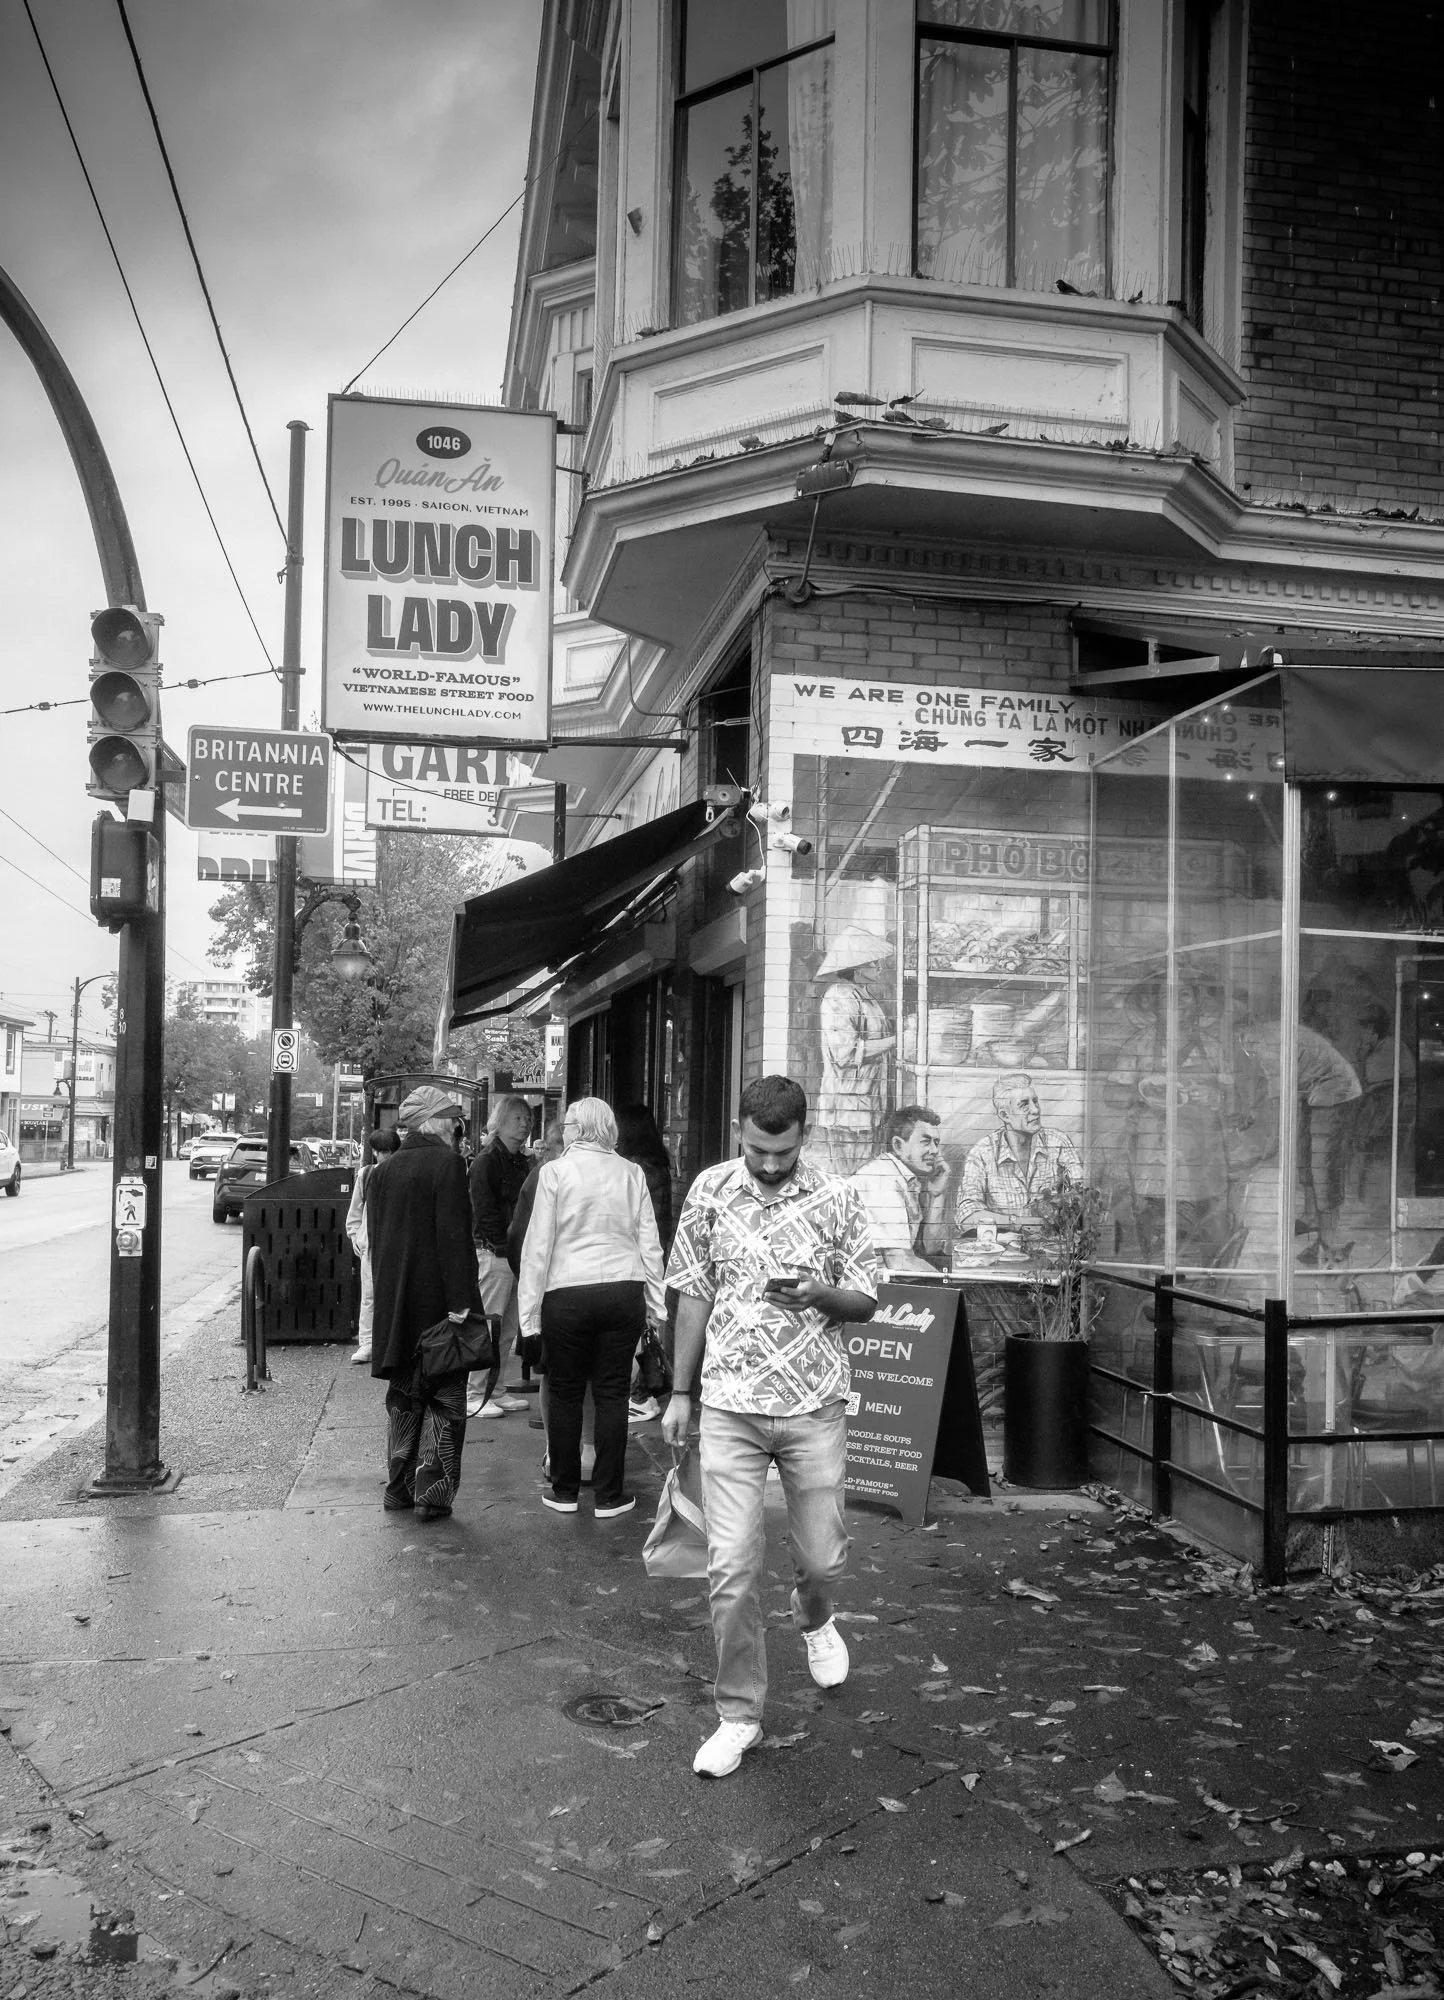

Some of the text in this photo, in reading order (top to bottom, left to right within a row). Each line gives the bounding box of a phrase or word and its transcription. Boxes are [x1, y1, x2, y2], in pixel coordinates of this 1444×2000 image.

[427, 434, 461, 451] 1046
[374, 457, 447, 489] Quán
[350, 496, 530, 517] EST. 1995 SAIGON, VIETNAM
[341, 517, 538, 588] LUNCH
[367, 594, 512, 661] LADY
[343, 683, 535, 702] VIETNAMESE STREET FOOD
[793, 682, 1077, 714] WE ARE ONE FAMILY
[363, 703, 522, 720] WWW.THELUNCHLADY.COM
[996, 710, 1022, 731] TA
[194, 738, 325, 766] BRITANNIA
[841, 725, 1077, 763] 四海一家
[214, 770, 304, 796] CENTRE
[443, 788, 475, 801] FREE
[377, 798, 427, 823] TEL:
[848, 1336, 913, 1361] OPEN
[854, 1368, 934, 1387] INS WELCOME
[865, 1401, 902, 1416] MENU
[847, 1428, 912, 1445] NOODLE SOUPS
[863, 1443, 898, 1456] STREET
[898, 1449, 923, 1459] FOOD
[846, 1454, 918, 1472] OCKTAILS, BEER
[856, 1485, 882, 1495] STREET
[881, 1489, 899, 1497] FOOD
